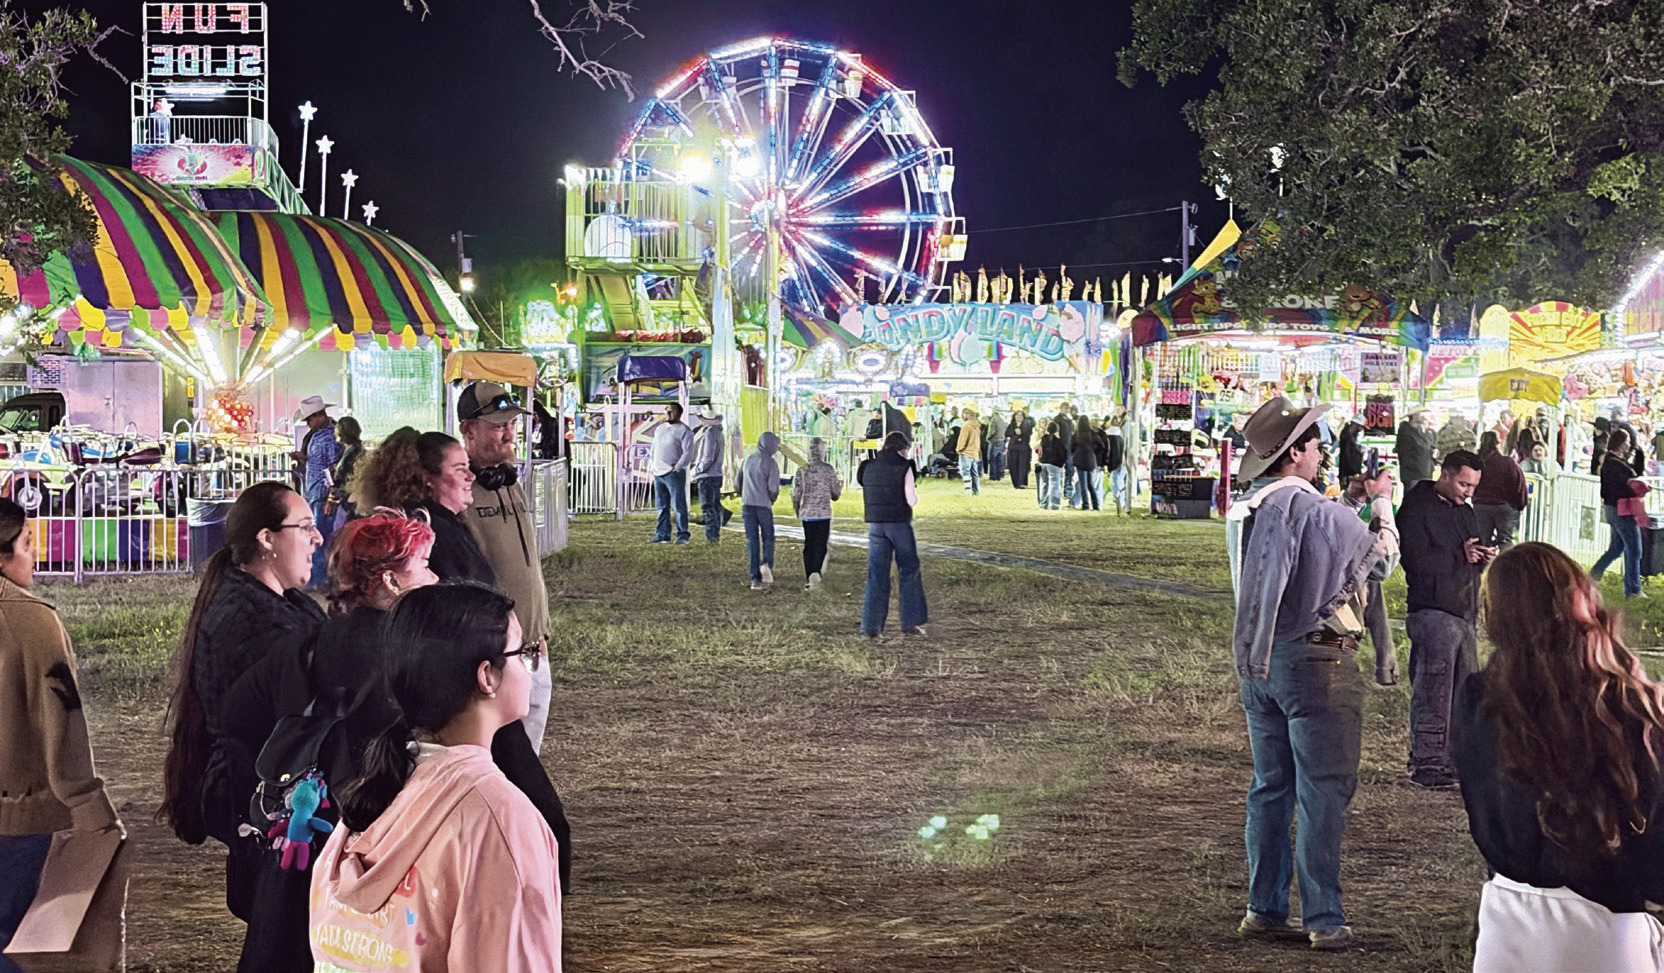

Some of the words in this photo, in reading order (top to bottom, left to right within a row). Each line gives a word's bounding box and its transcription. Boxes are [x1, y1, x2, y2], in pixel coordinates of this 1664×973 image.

[977, 306, 1066, 362] LAND
[1169, 323, 1210, 332] LIGHT
[1262, 323, 1290, 331] IDS
[1292, 323, 1329, 332] TOYS
[1358, 326, 1400, 336] MORE
[320, 924, 341, 947] AM
